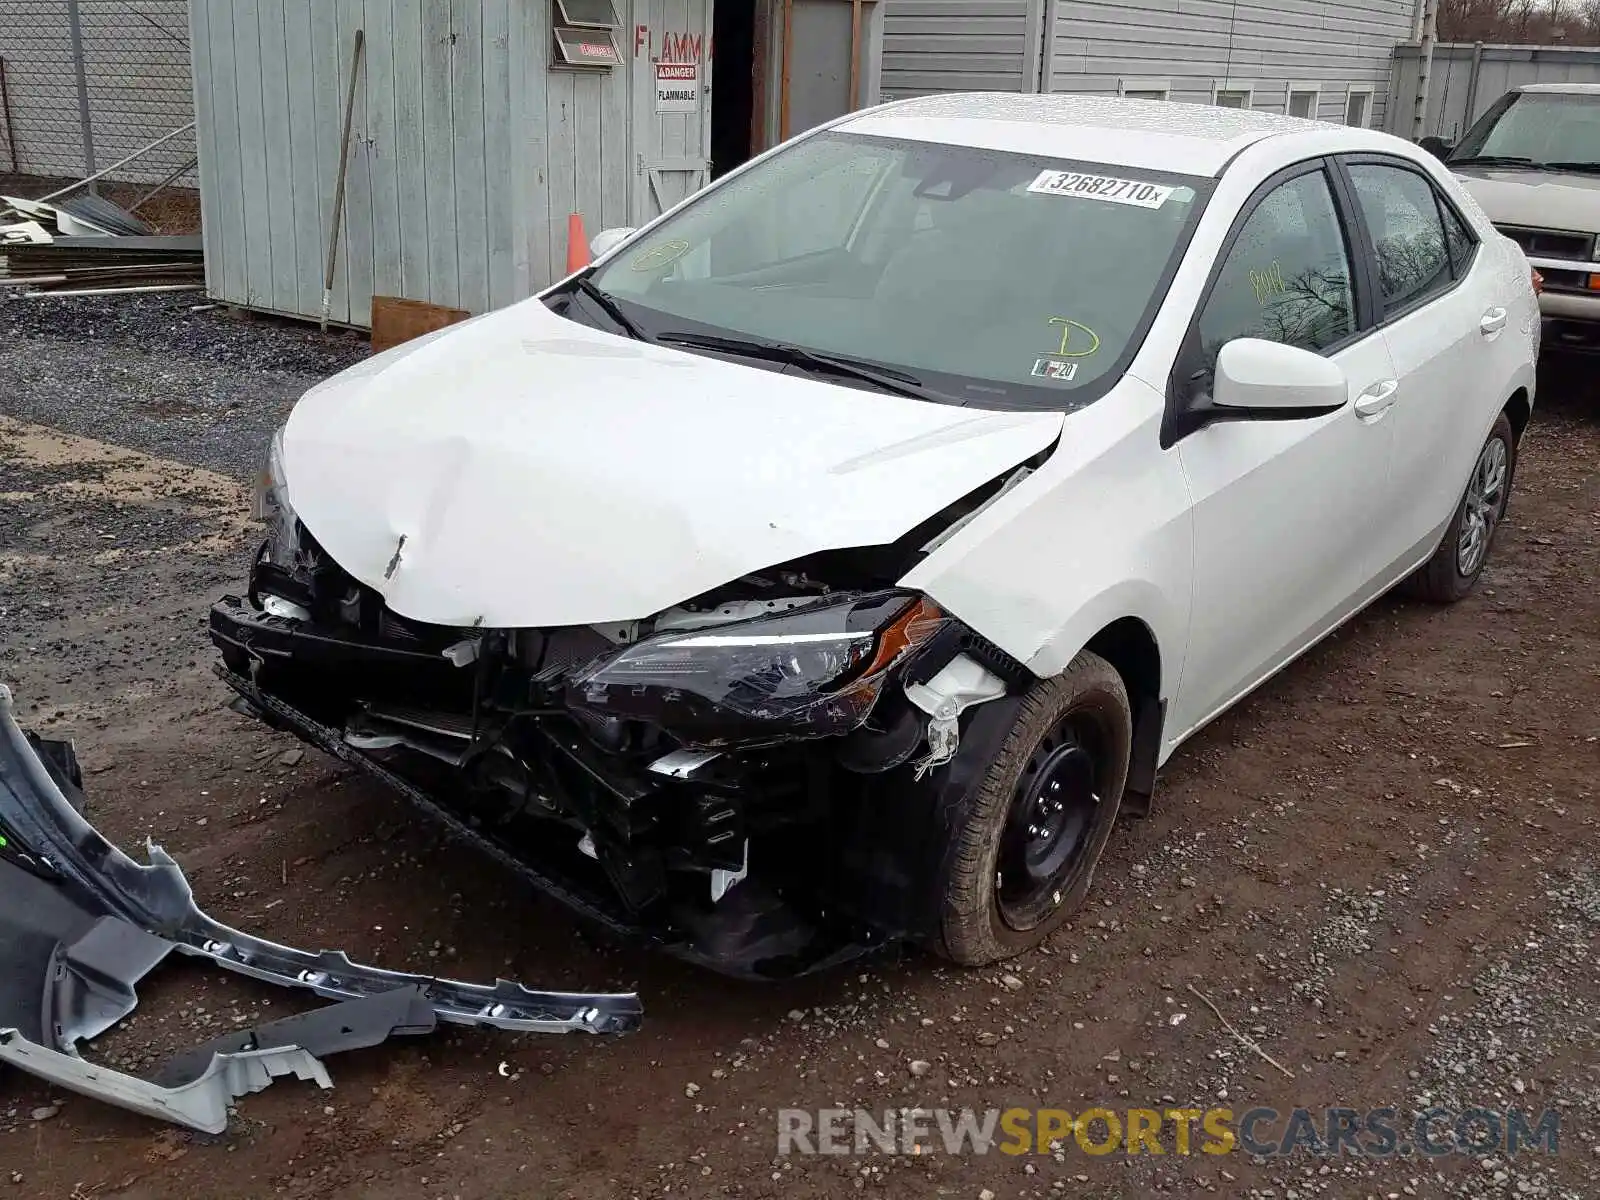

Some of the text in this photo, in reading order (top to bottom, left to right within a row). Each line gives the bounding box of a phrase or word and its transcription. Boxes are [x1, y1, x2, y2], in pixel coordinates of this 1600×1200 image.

[664, 66, 695, 78] DANGER
[658, 90, 695, 101] FLAMMABLE
[1047, 317, 1100, 357] D
[1058, 362, 1074, 377] 20
